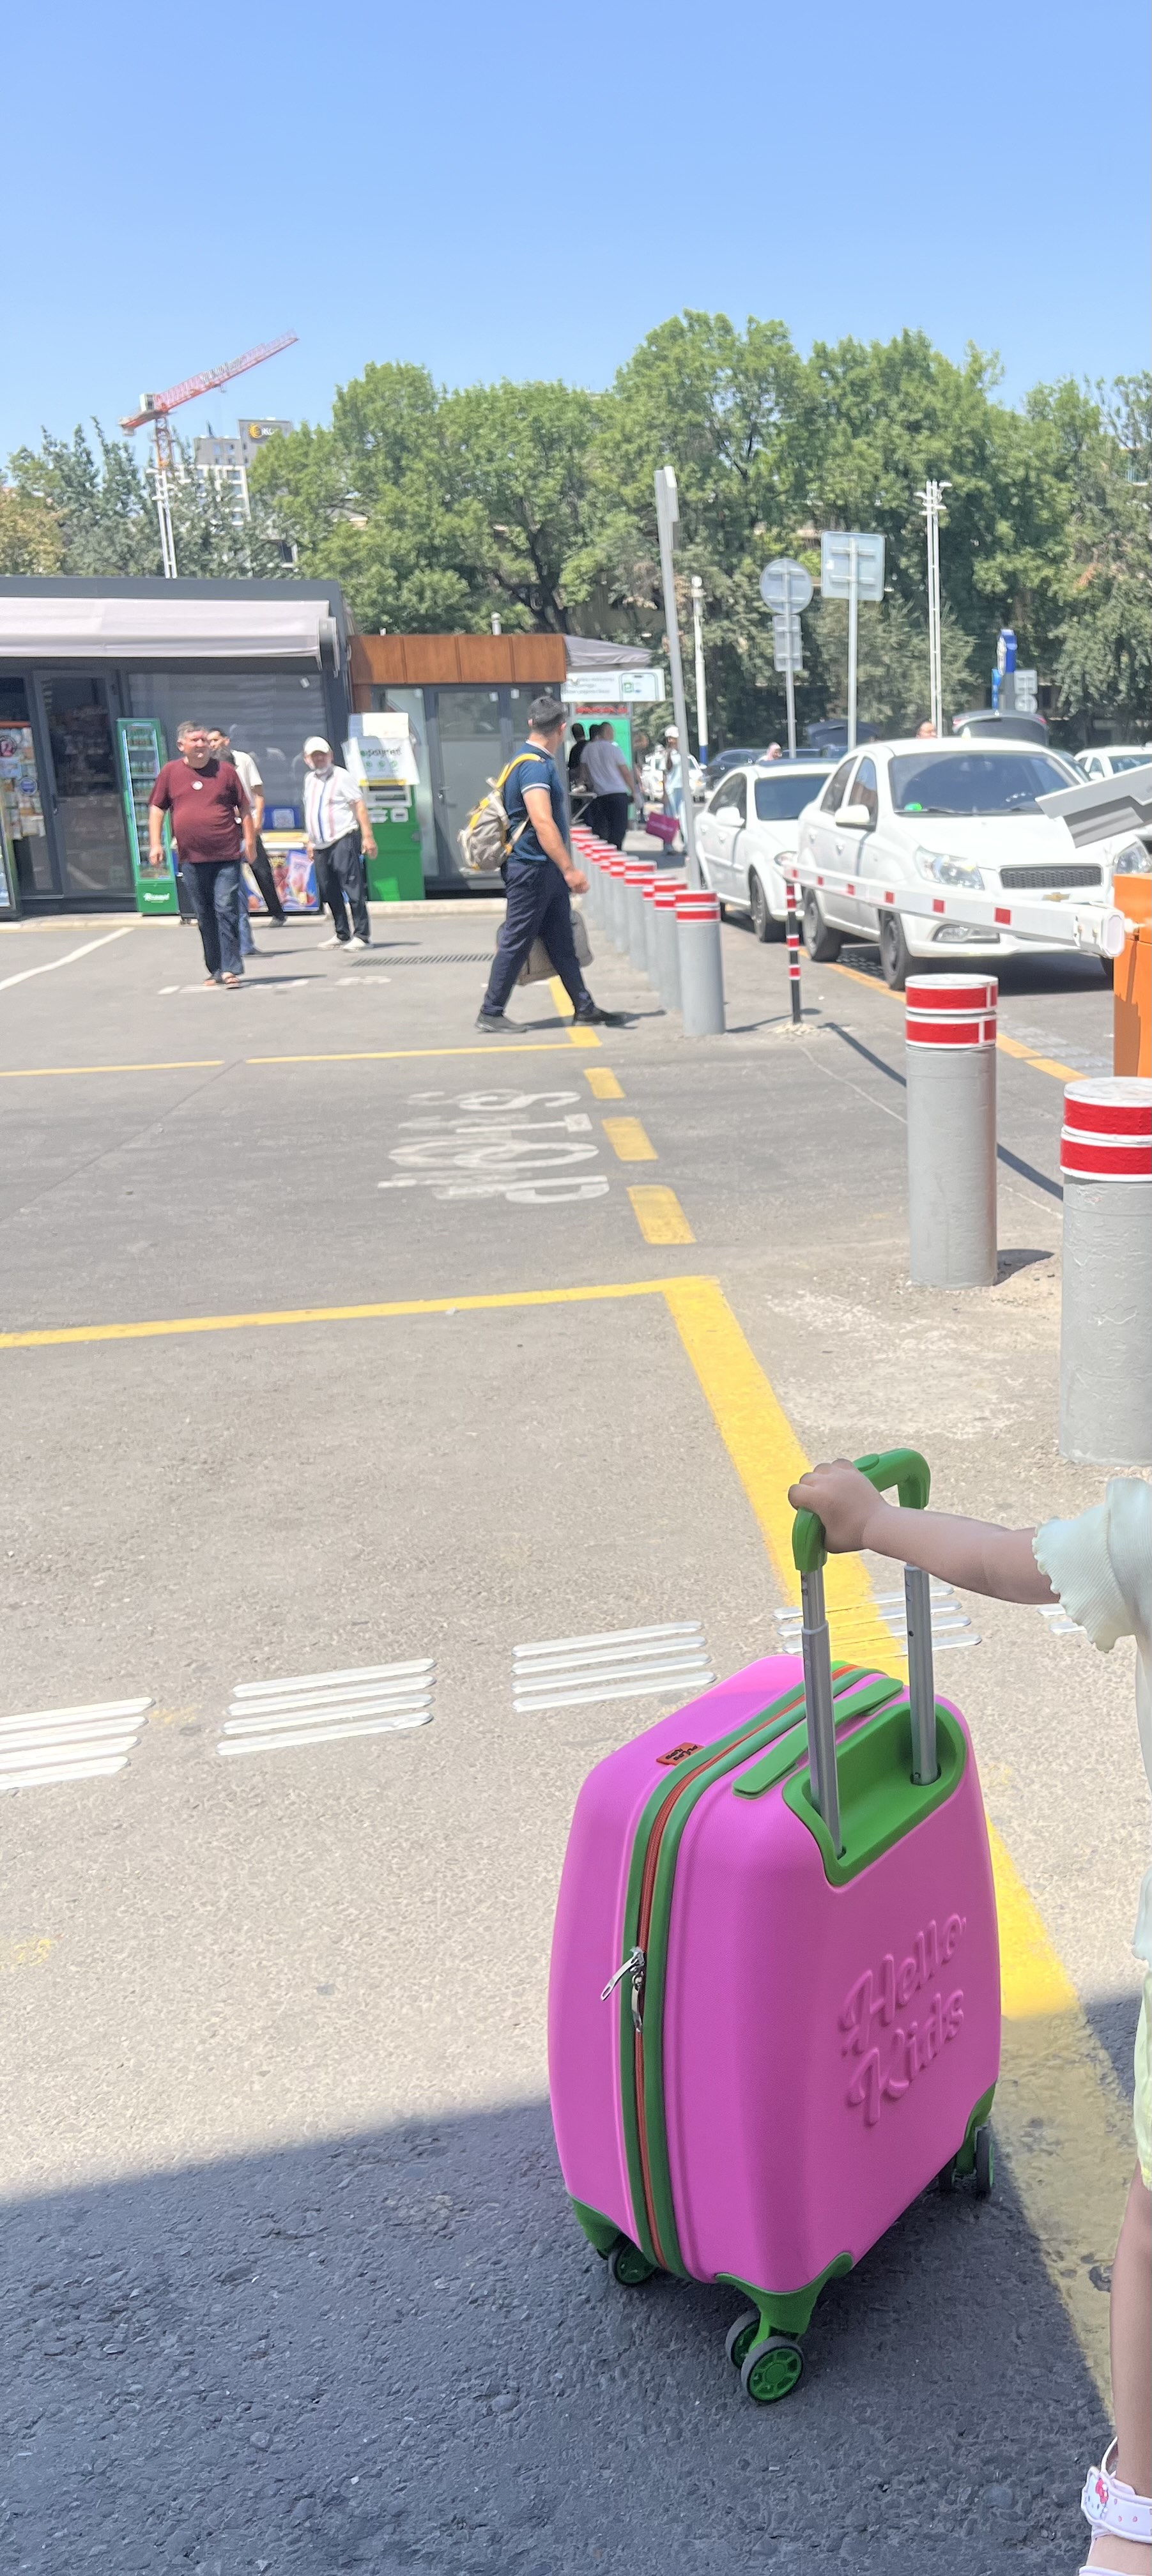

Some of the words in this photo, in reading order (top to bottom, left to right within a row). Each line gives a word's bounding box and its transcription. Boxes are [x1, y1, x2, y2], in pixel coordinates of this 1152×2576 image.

[433, 1088, 610, 1204] STOP
[838, 1913, 967, 2058] Hello
[847, 1988, 964, 2127] Kids
